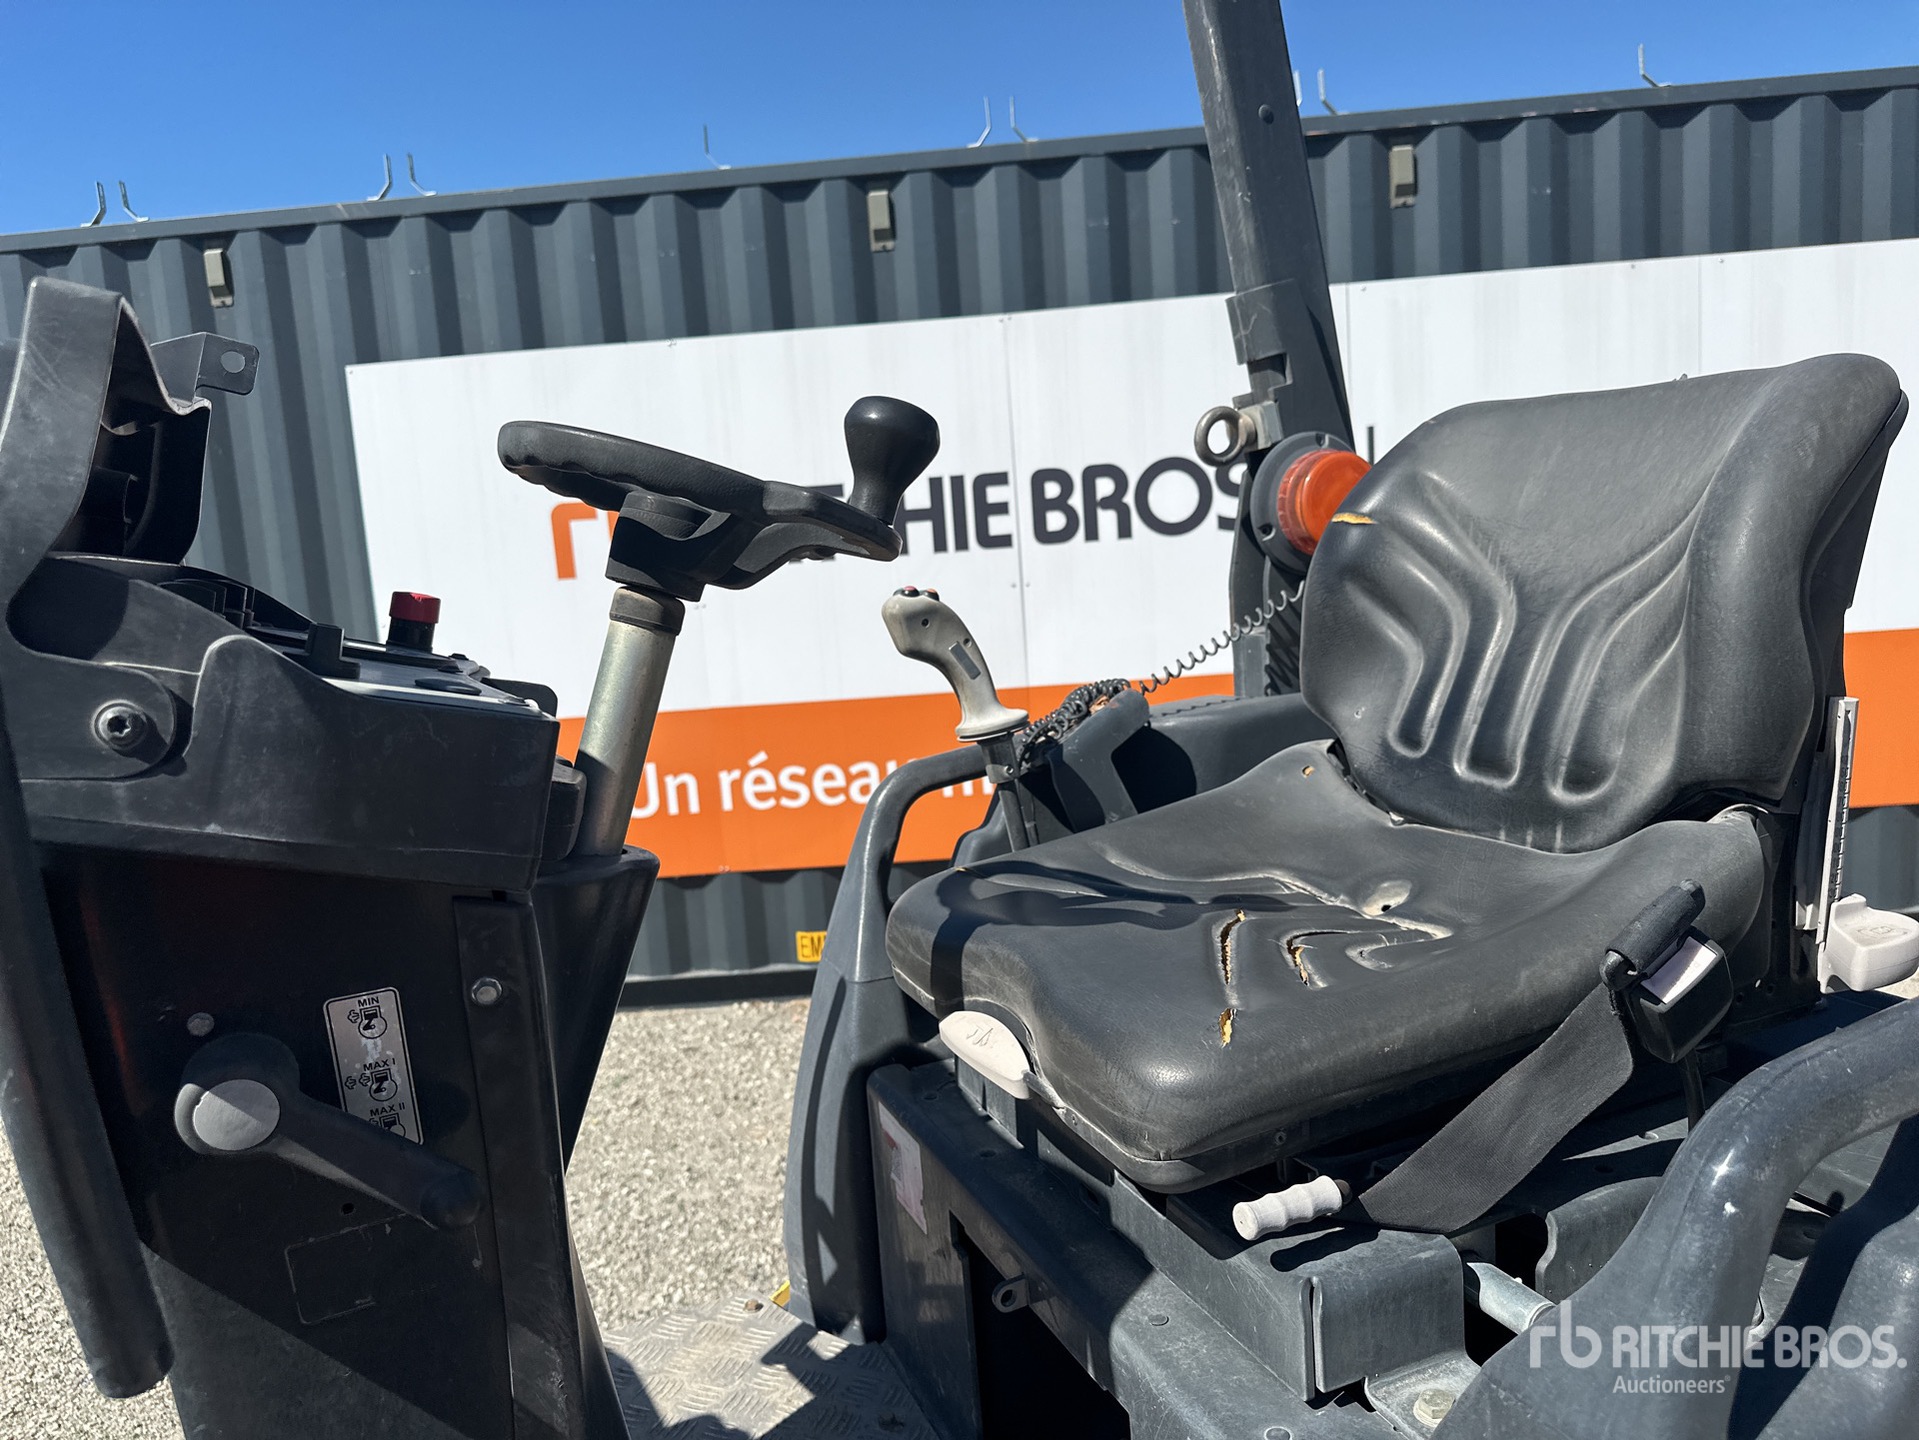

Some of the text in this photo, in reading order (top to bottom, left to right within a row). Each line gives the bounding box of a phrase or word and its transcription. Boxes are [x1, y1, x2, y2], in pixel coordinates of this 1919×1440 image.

[717, 750, 912, 813] résea
[358, 997, 380, 1007] MIN
[363, 1060, 389, 1071] MAX
[369, 1106, 396, 1116] MAX
